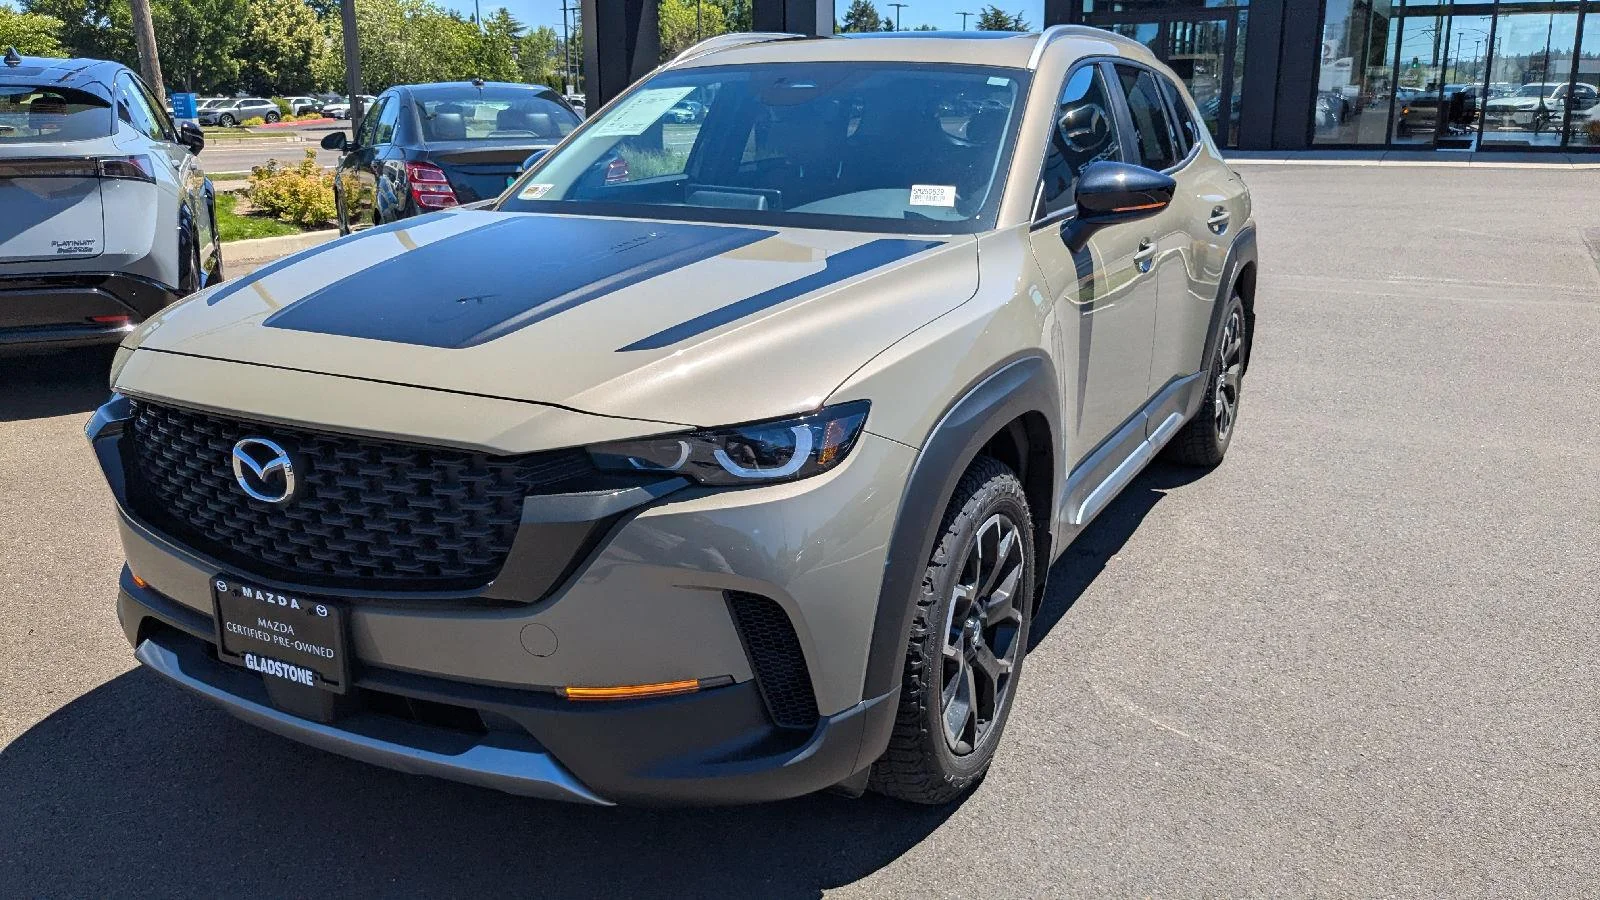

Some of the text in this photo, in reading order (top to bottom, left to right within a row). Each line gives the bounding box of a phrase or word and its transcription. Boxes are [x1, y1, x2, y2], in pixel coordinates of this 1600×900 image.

[241, 586, 301, 610] MAZDA
[226, 621, 334, 659] CERTIFIED PRE-OWNED
[257, 617, 295, 636] MAZDA
[245, 653, 314, 687] GLADSTONE
